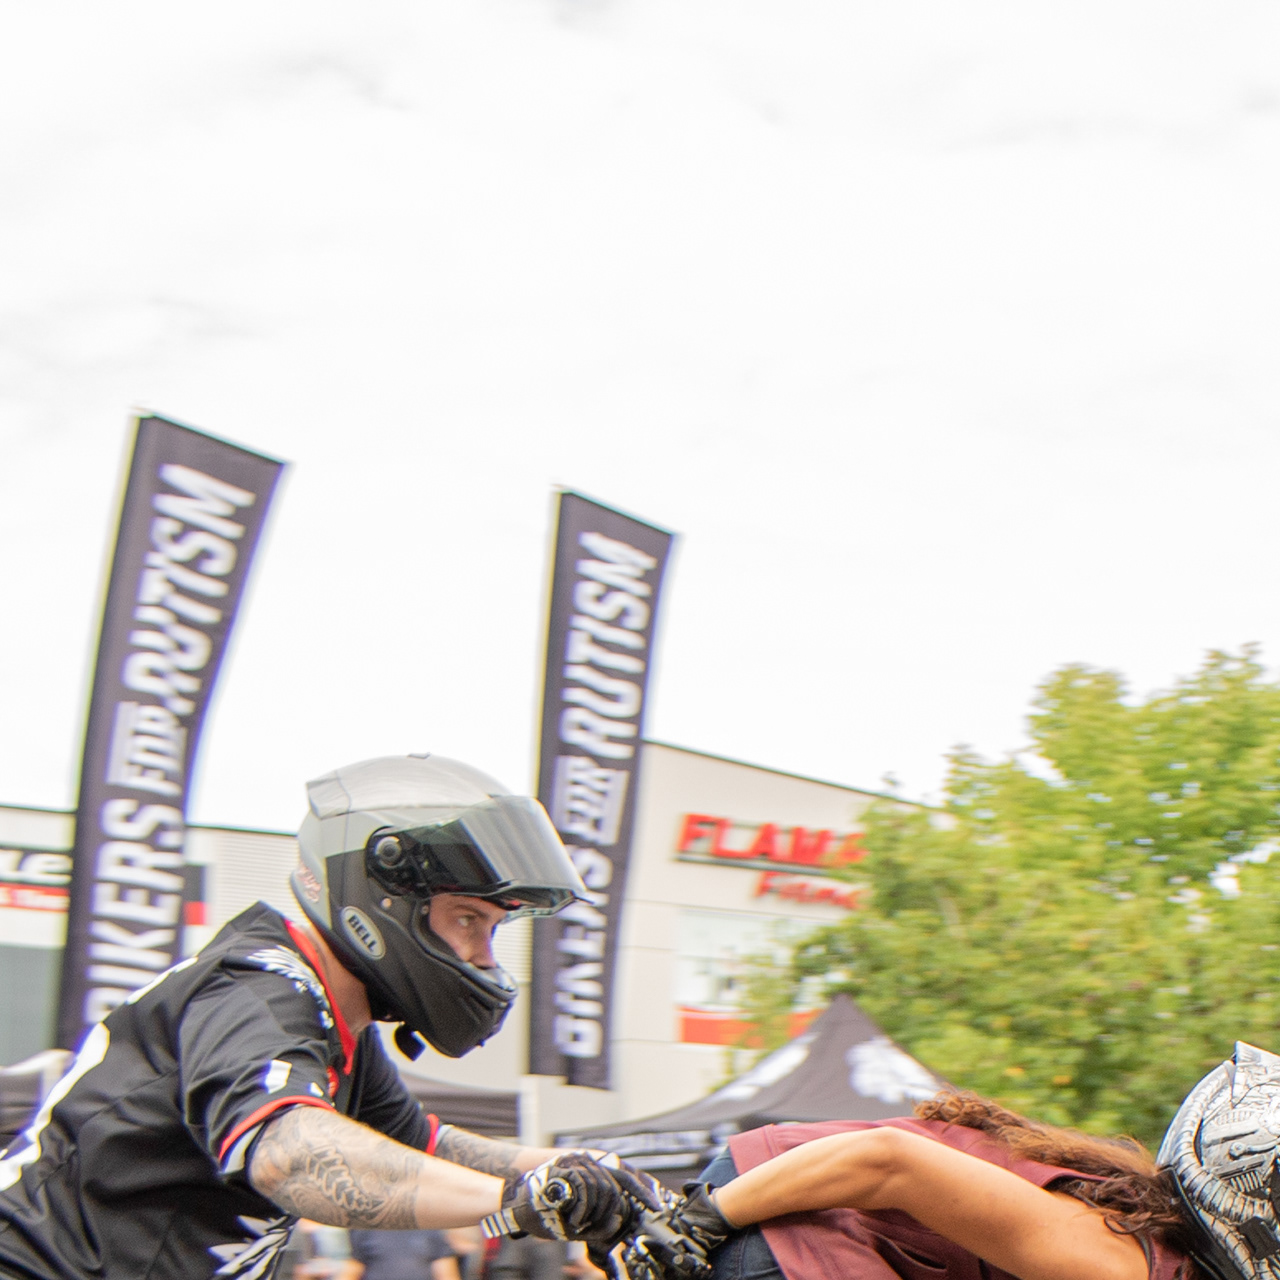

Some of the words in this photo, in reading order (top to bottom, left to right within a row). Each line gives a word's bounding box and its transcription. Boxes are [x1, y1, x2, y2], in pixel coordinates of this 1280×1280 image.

[122, 463, 256, 715] AUTISM
[558, 531, 658, 760] AUTISM
[348, 915, 377, 952] BELL
